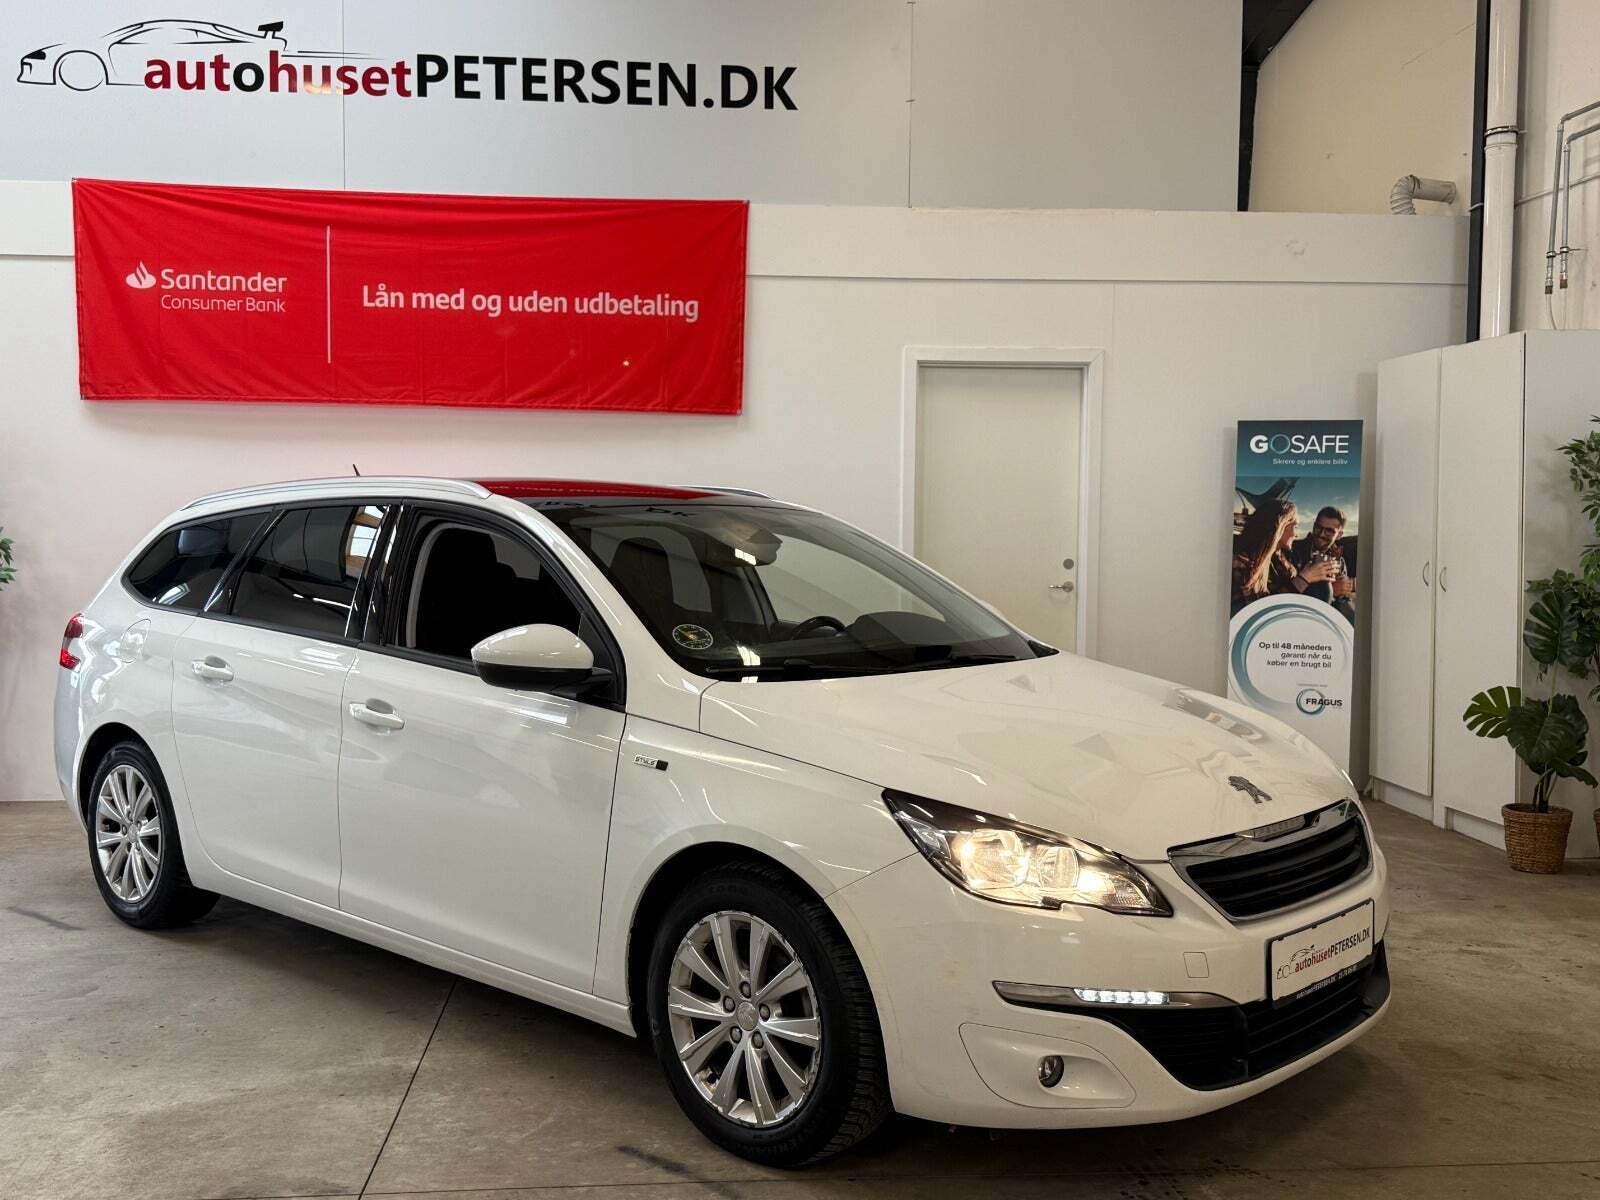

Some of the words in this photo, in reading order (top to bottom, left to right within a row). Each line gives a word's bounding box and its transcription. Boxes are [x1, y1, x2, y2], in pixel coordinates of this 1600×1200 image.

[160, 268, 287, 293] Santander
[161, 295, 243, 311] Consumer
[245, 297, 286, 313] Bank
[362, 283, 404, 308] Lån
[411, 288, 465, 310] med
[471, 293, 502, 317] og
[508, 290, 568, 313] uden
[574, 292, 700, 323] udbetaling
[1249, 433, 1350, 454] GOSAFE
[1258, 641, 1271, 650] Op
[1281, 642, 1292, 650] 48
[1293, 643, 1332, 651] måneders
[1280, 652, 1306, 660] garanti
[1308, 652, 1320, 660] når
[1301, 661, 1321, 669] brugt
[1305, 698, 1343, 706] FRAGUS
[1294, 928, 1371, 973] autohusetPETERSEN.DK
